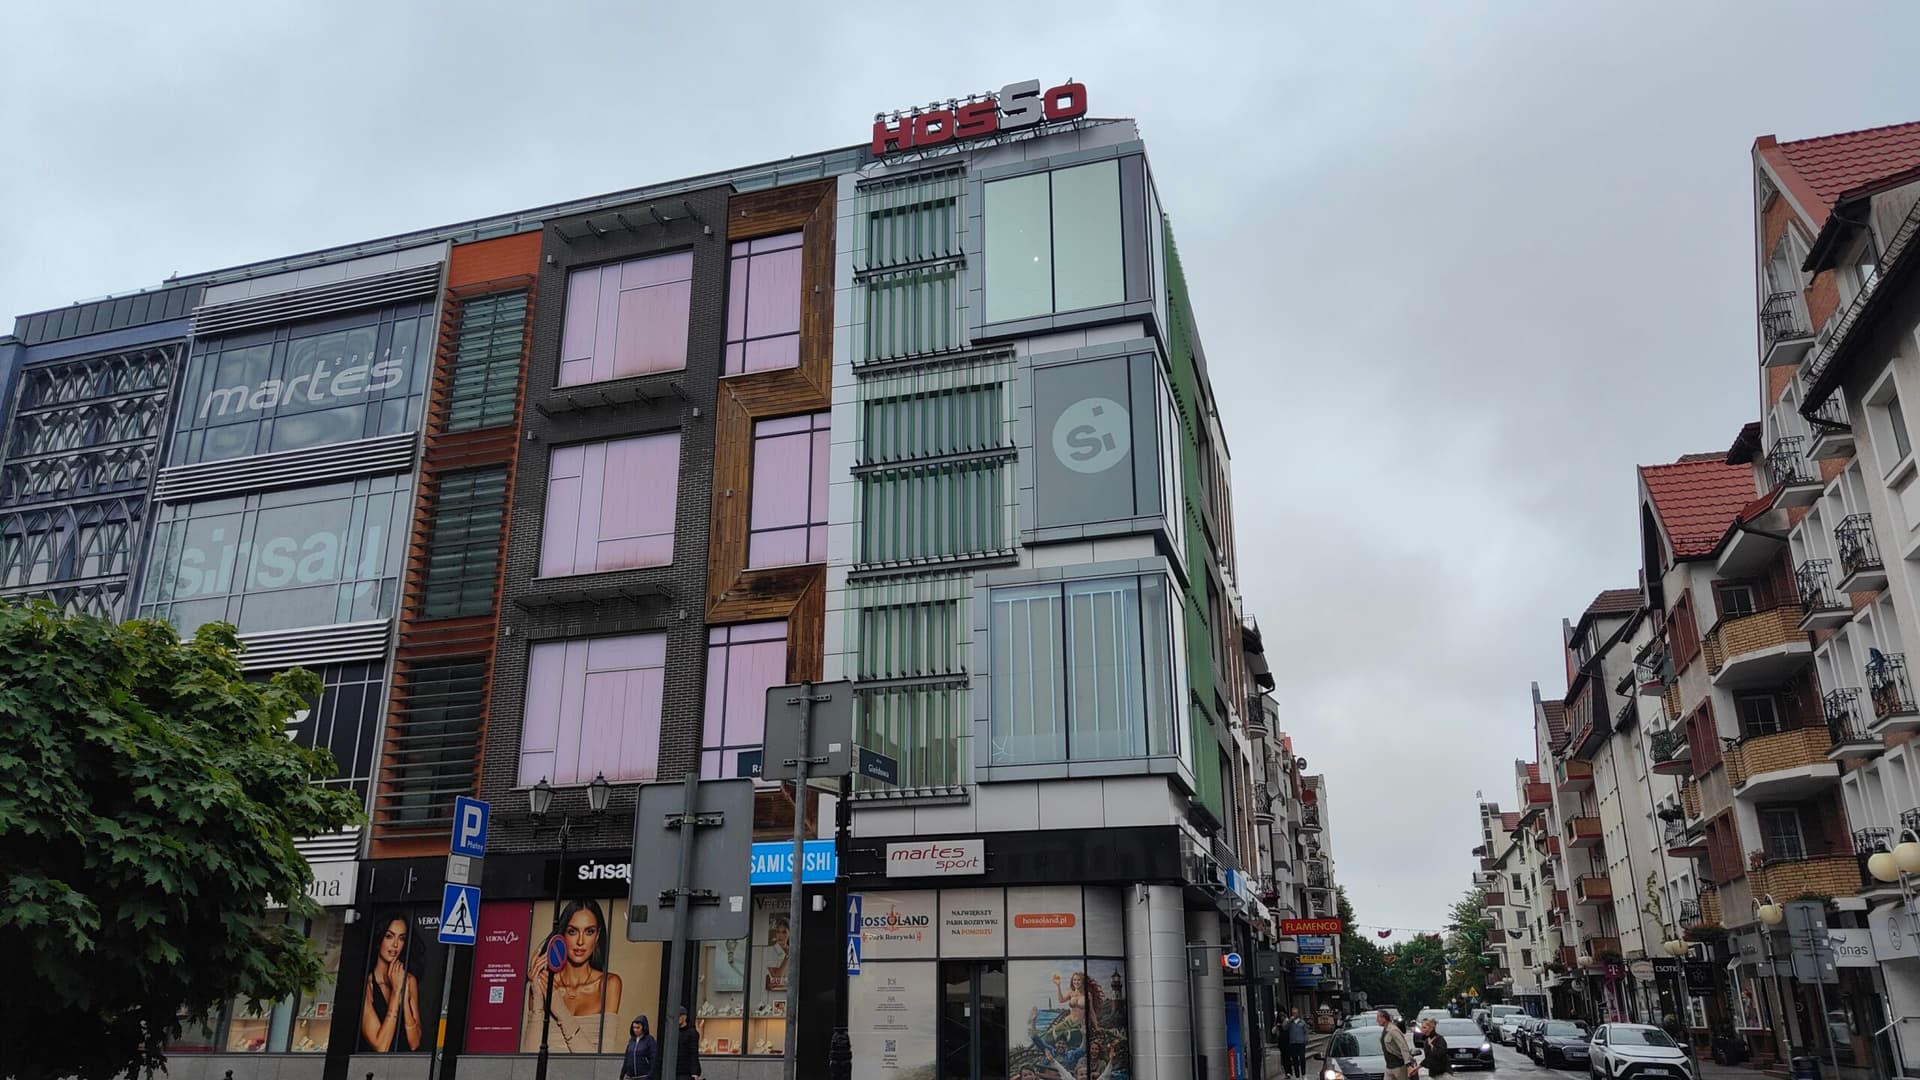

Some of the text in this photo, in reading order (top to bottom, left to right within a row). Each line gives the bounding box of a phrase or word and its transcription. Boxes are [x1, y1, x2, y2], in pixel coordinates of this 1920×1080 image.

[872, 79, 1088, 156] HOSSO
[200, 358, 404, 419] martes
[164, 526, 382, 599] sinsay
[891, 845, 965, 861] martes
[935, 856, 980, 872] sport
[418, 916, 441, 925] VERON
[1286, 922, 1337, 931] FLAMENCO
